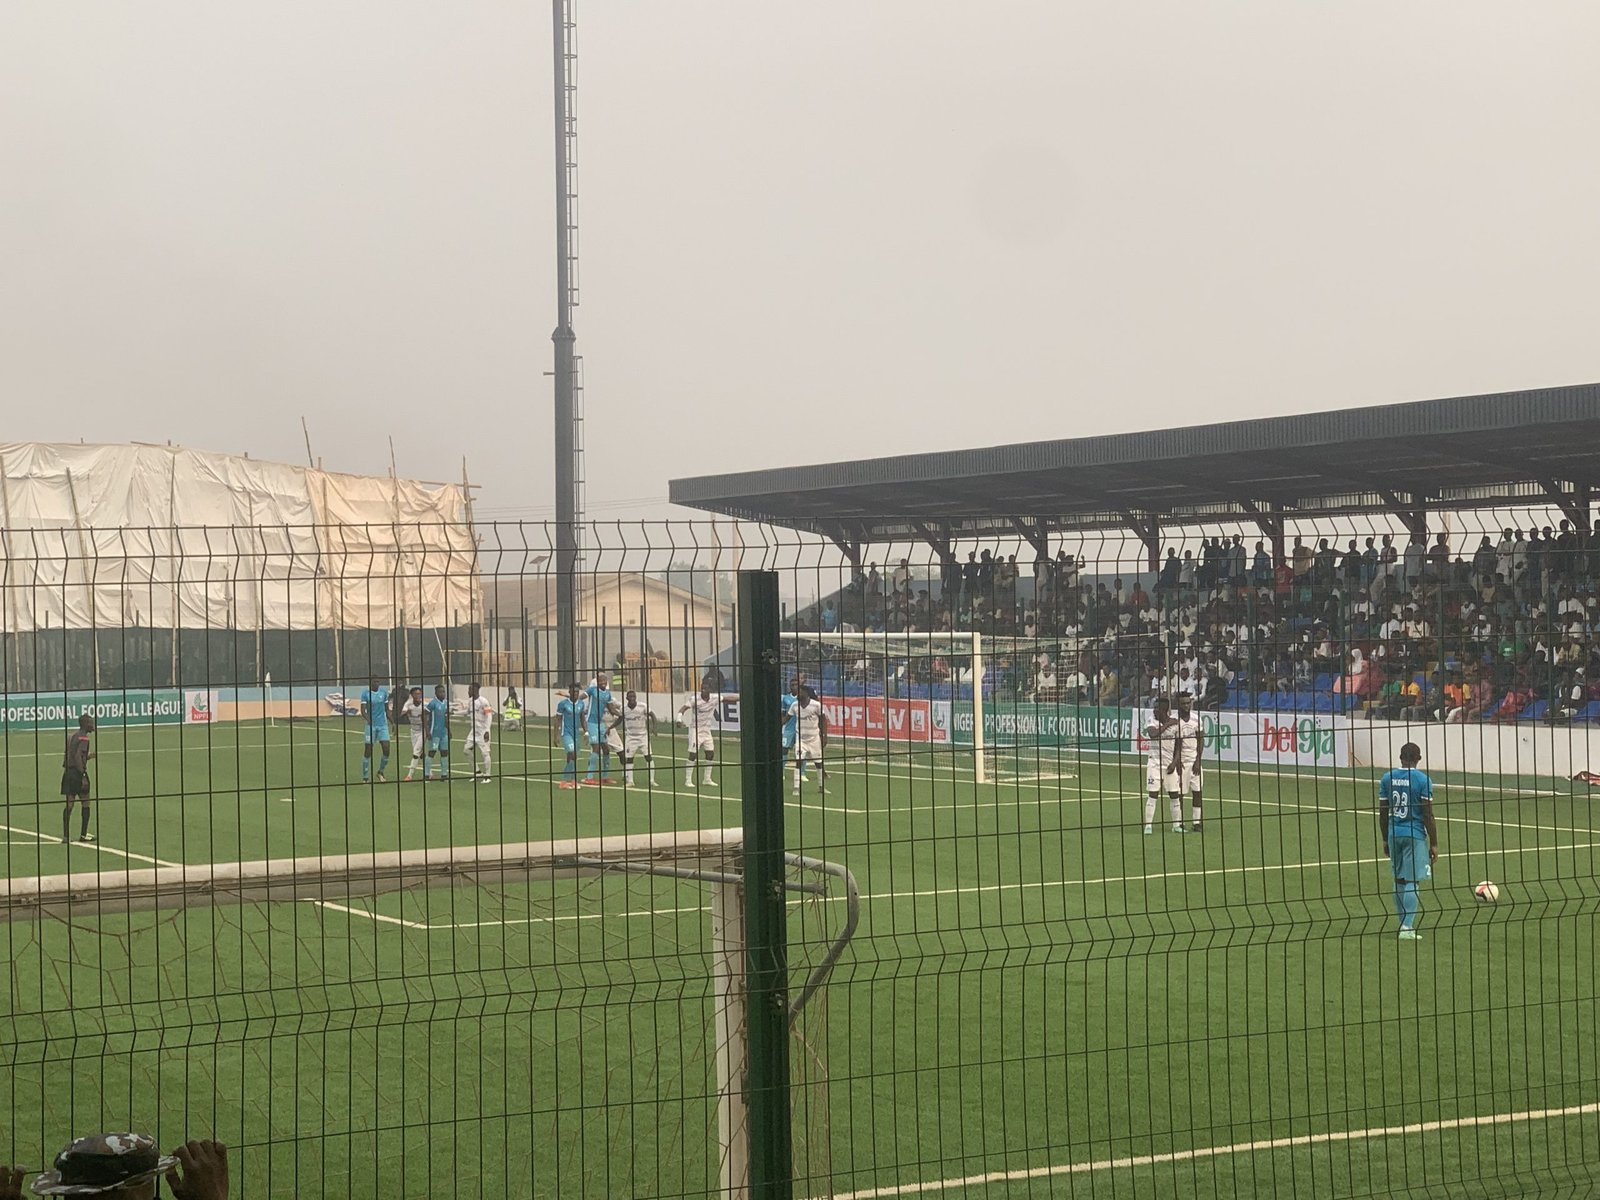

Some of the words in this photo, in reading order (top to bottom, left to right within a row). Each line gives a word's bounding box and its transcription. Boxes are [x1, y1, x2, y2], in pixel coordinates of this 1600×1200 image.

[81, 702, 139, 718] FOOTBALL
[984, 714, 1046, 735] PROFESSIONAL
[1047, 716, 1093, 737] FOOTBALL
[1094, 718, 1131, 739] LEAGUE
[1262, 716, 1334, 761] bet9ja
[1392, 790, 1408, 819] 23
